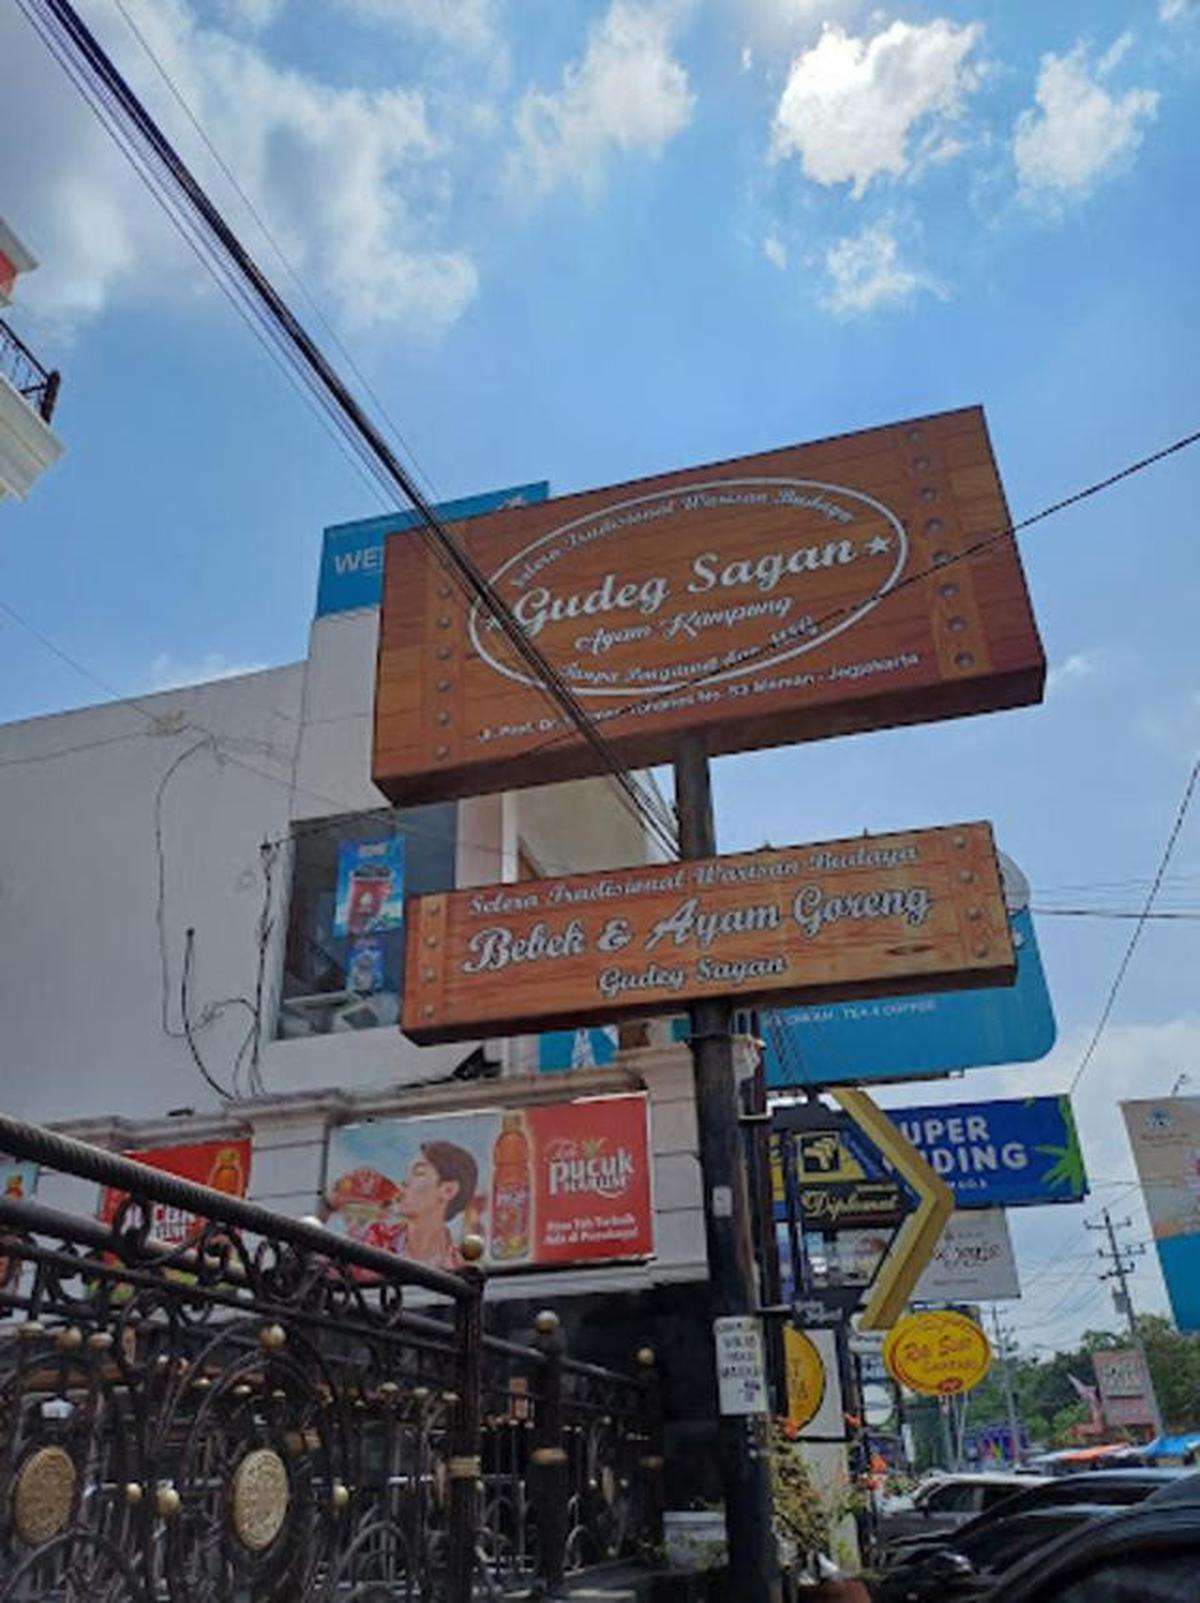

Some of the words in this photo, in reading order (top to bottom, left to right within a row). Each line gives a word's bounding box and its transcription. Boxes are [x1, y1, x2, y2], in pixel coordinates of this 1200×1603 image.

[334, 545, 384, 574] WE
[512, 573, 670, 637] Gudeg
[687, 538, 858, 594] Sagan
[656, 596, 794, 640] Kampung
[462, 917, 587, 976] Bebek
[596, 918, 632, 953] &
[643, 896, 780, 947] Ayam
[792, 884, 934, 939] Goreng
[696, 954, 788, 987] Sagan
[900, 1115, 991, 1146] UPER
